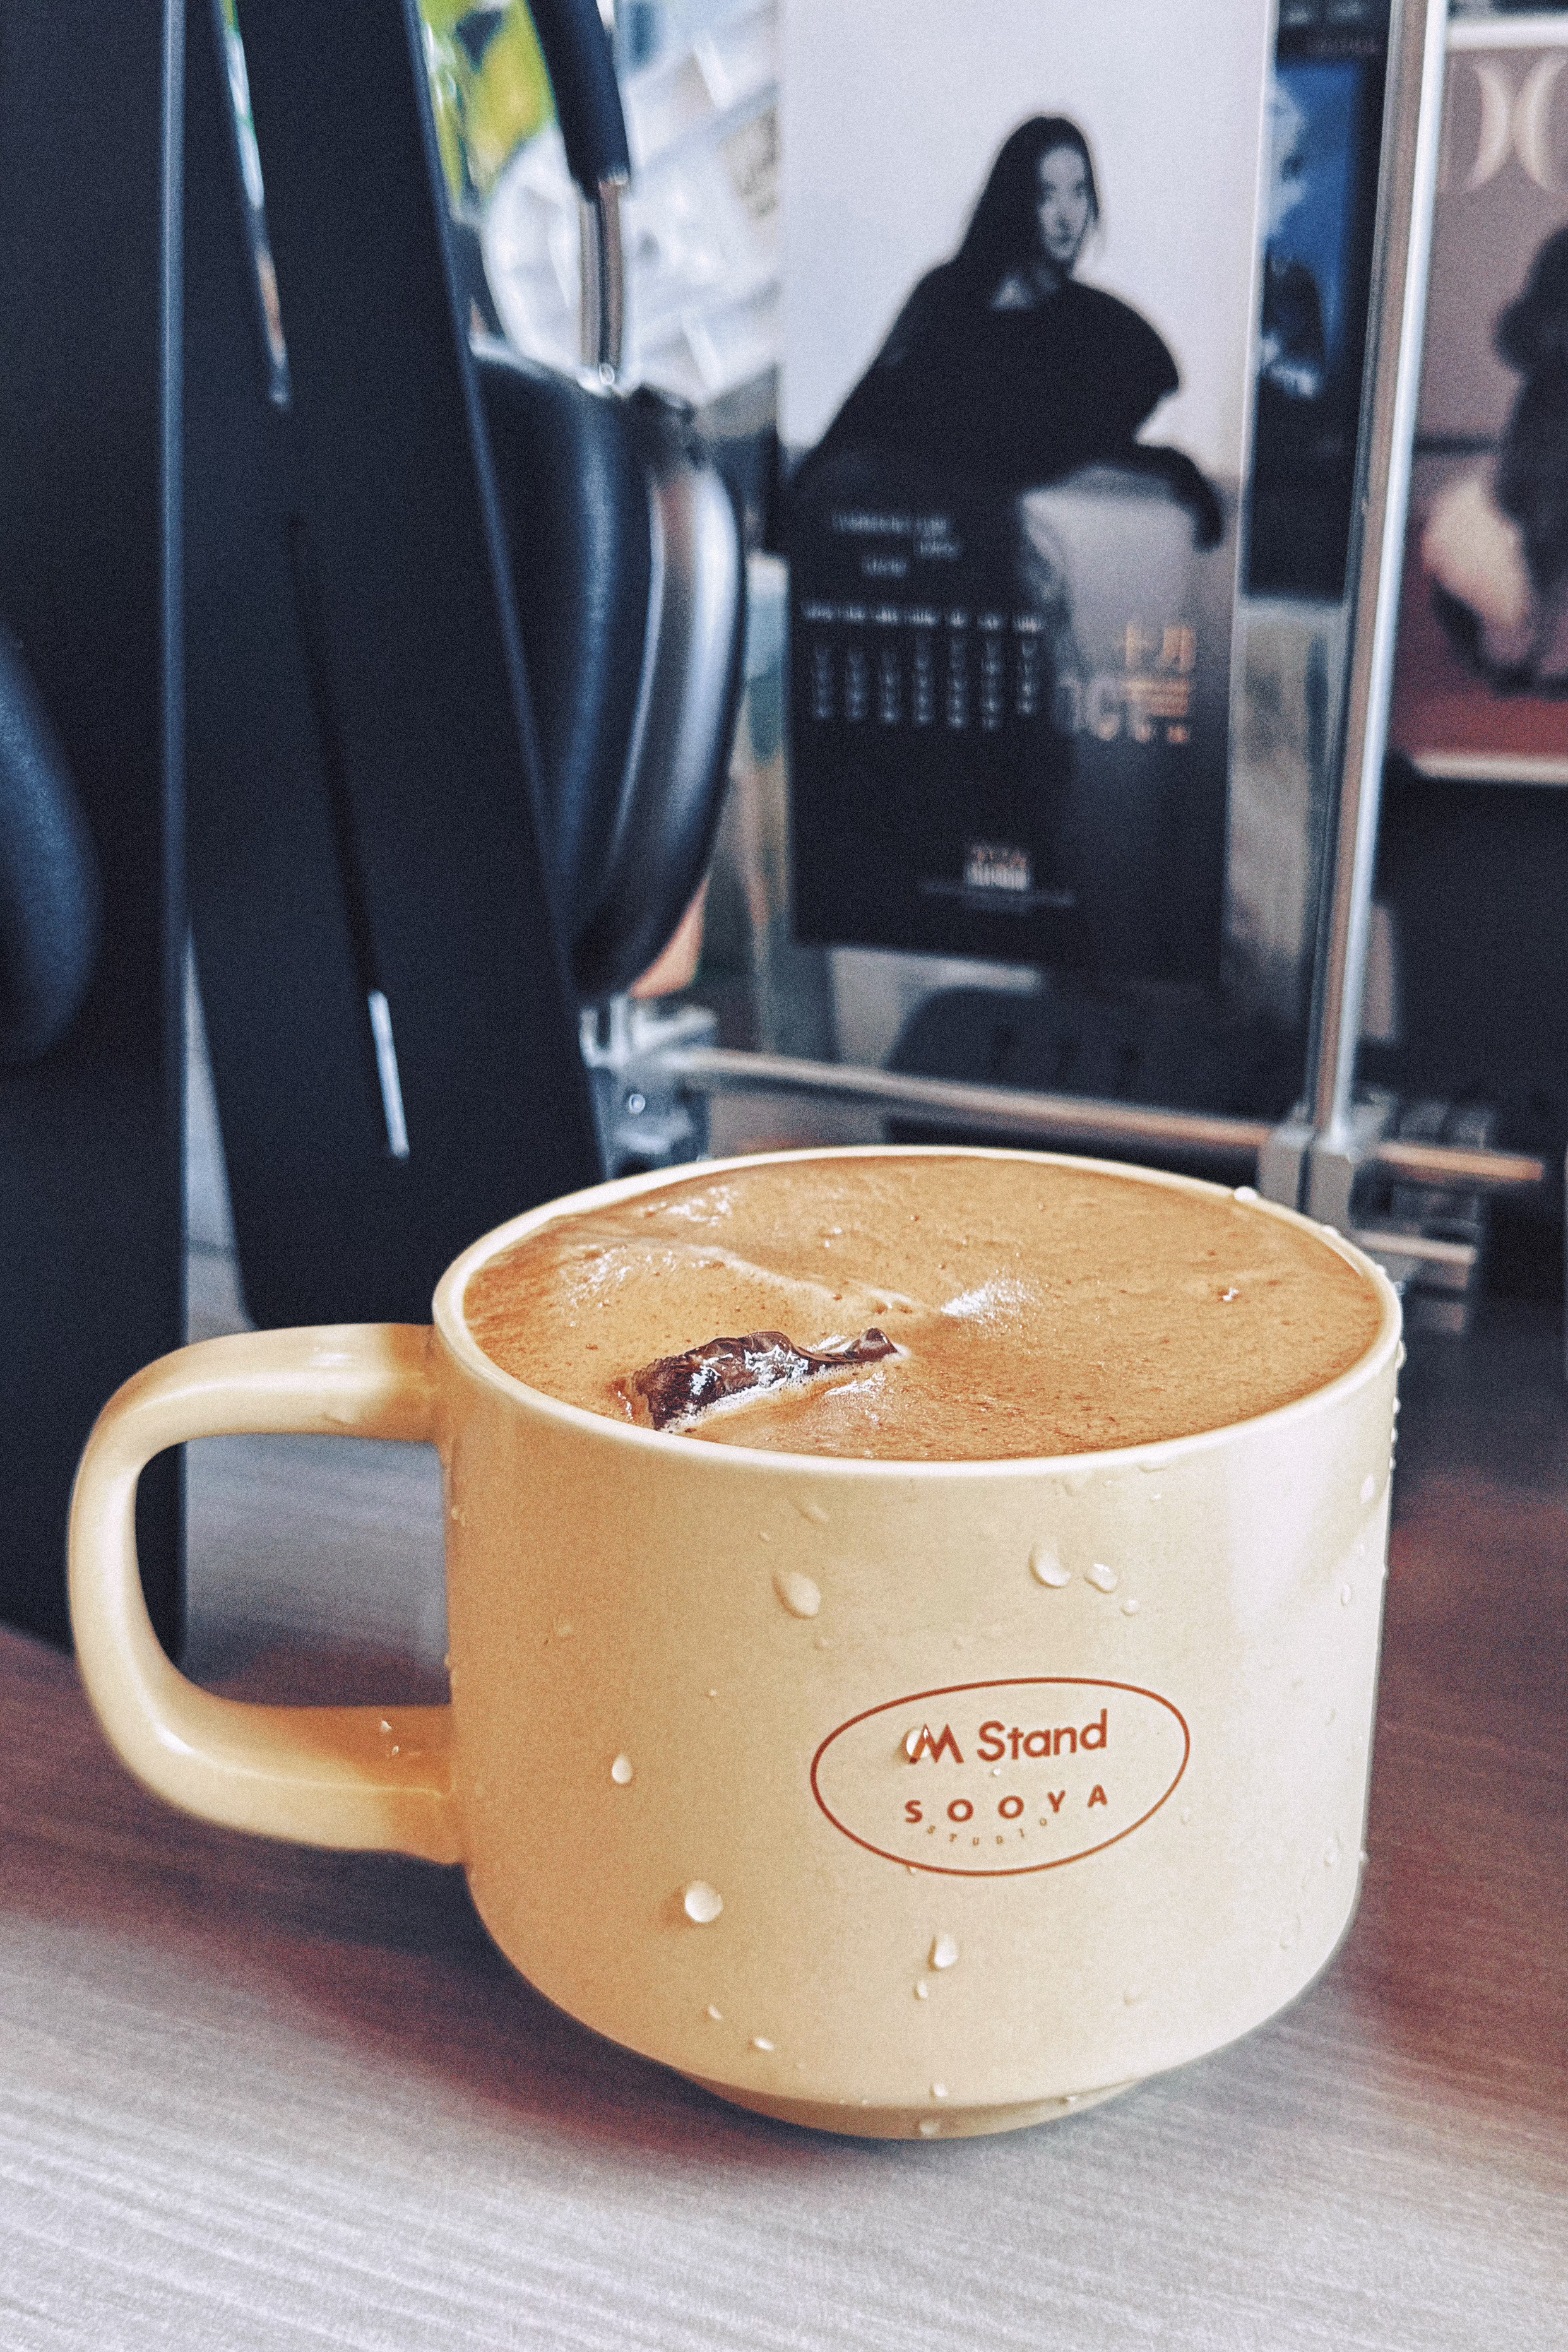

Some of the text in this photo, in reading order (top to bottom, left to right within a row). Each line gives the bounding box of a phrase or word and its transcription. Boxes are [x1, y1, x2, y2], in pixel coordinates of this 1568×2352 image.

[908, 1708, 1108, 1765] M Stand
[904, 1784, 1108, 1823] SOOYA
[926, 1817, 1048, 1847] STUDIO
